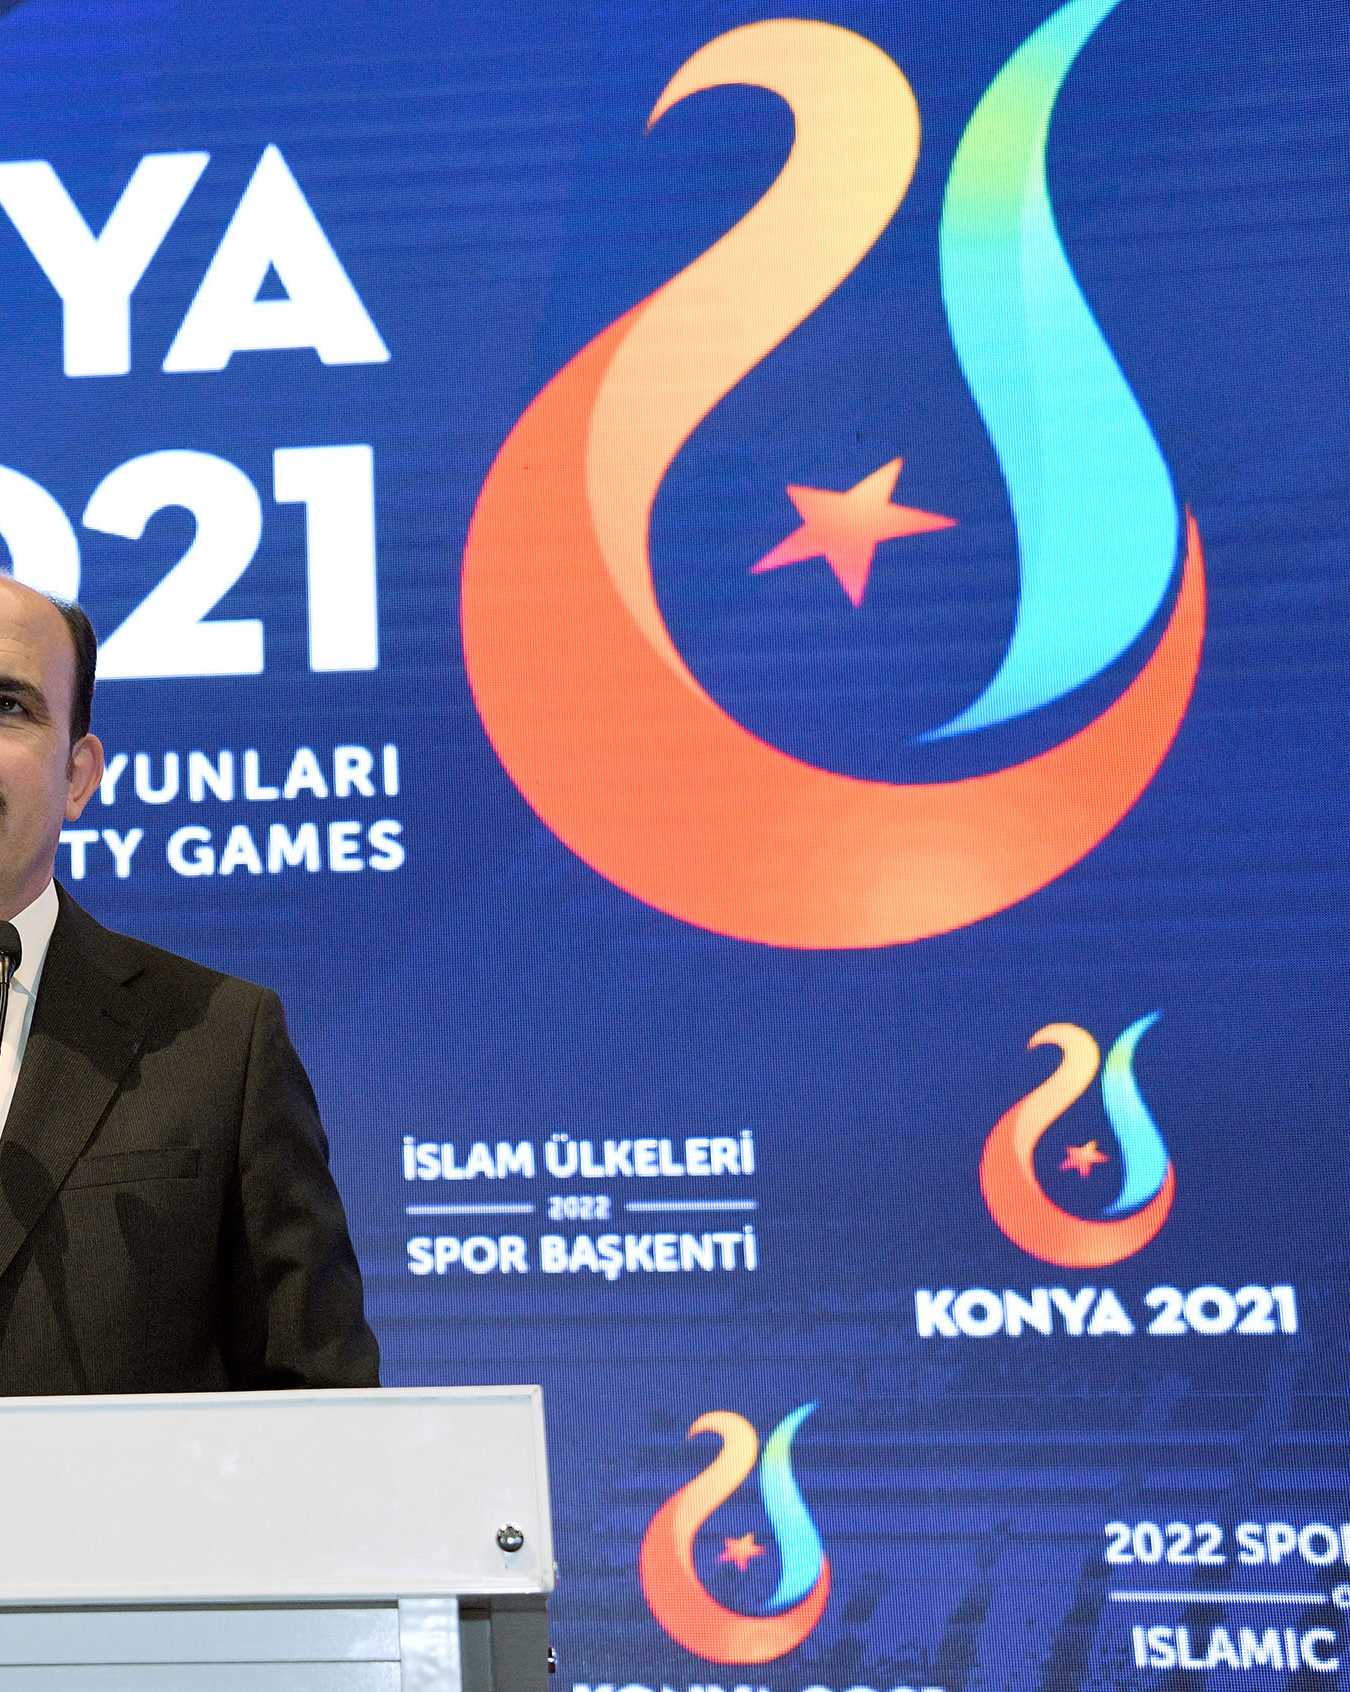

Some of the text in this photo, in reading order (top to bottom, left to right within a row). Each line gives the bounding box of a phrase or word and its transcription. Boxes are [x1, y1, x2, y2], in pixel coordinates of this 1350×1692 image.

[100, 744, 399, 805] YUNLARI
[166, 820, 405, 877] GAMES
[403, 1130, 755, 1180] İSLAM ÜLKELERİ
[547, 1195, 610, 1221] 2022
[406, 1225, 757, 1280] SPOR BAŞKENTİ
[914, 1285, 1298, 1338] KONYA 2021
[1105, 1521, 1350, 1566] 2022 SPO
[1132, 1625, 1340, 1673] ISLAMIC
